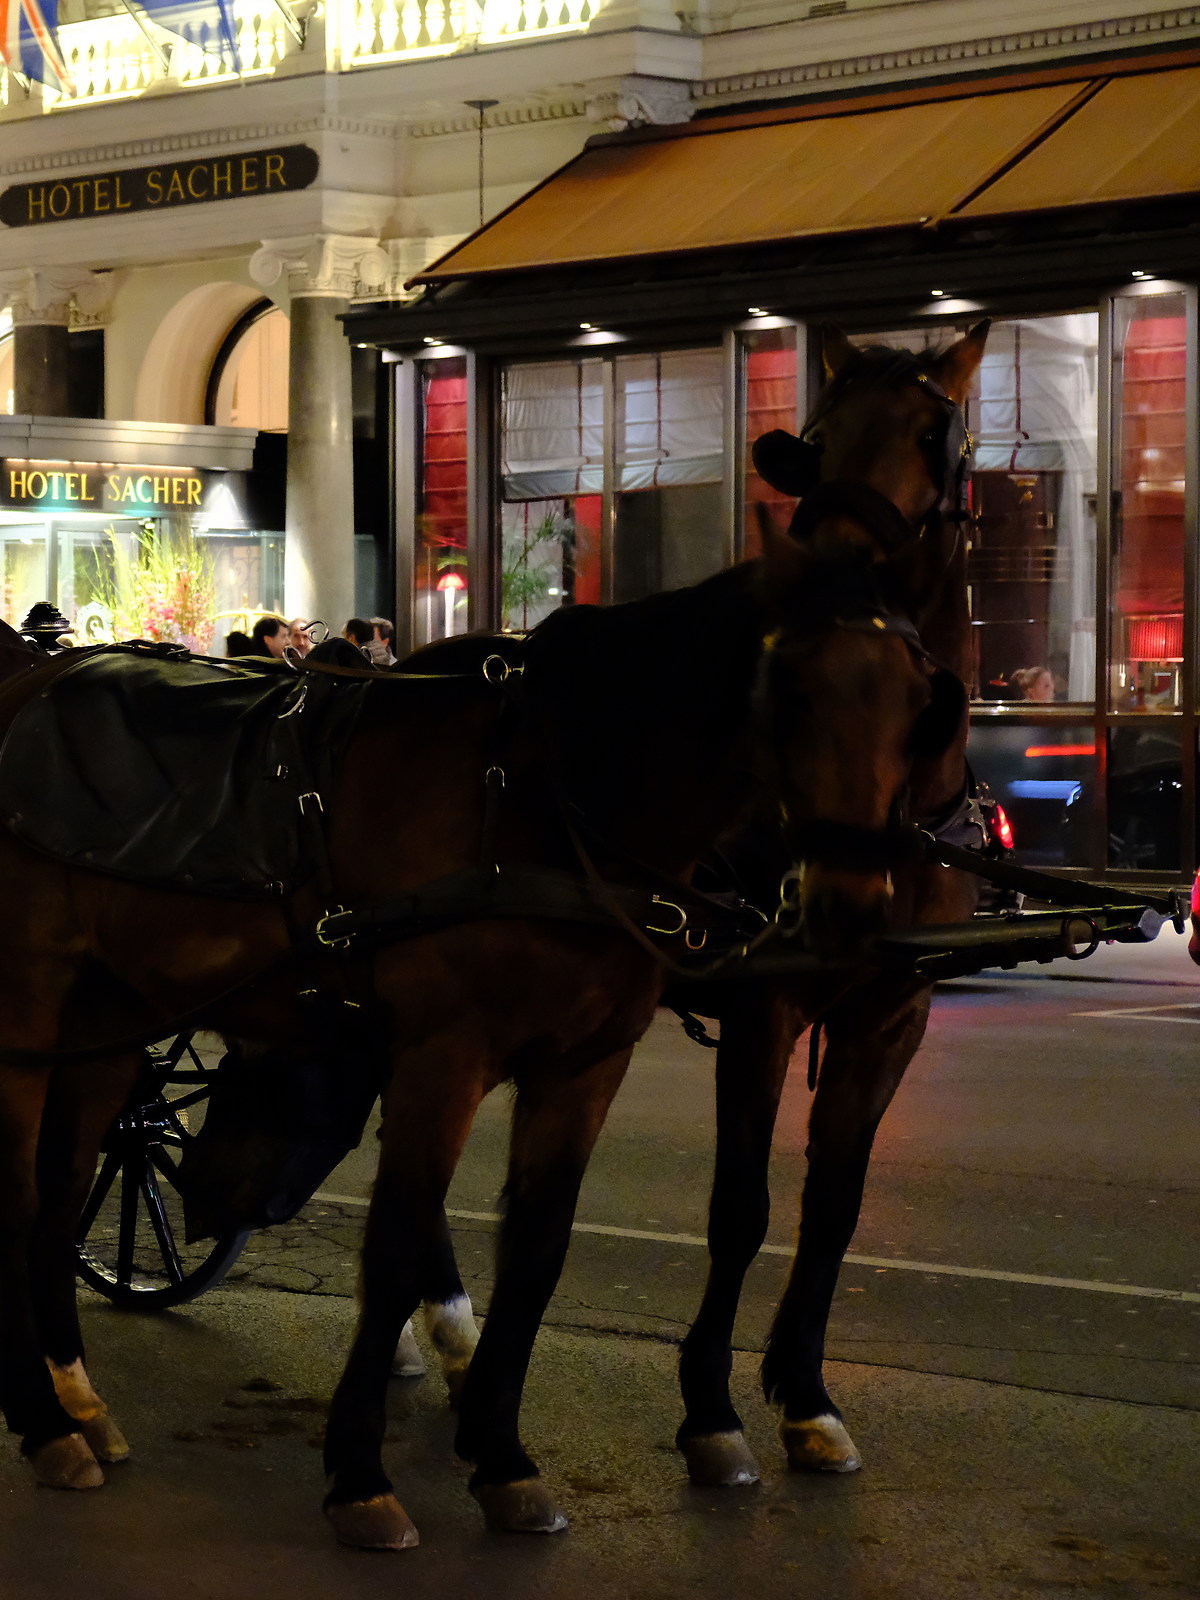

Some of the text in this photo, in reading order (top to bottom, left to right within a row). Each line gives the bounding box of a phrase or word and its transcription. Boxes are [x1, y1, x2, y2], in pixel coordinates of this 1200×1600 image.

[27, 154, 287, 220] HOTEL SACHER
[9, 470, 202, 505] HOTEL SACHER
